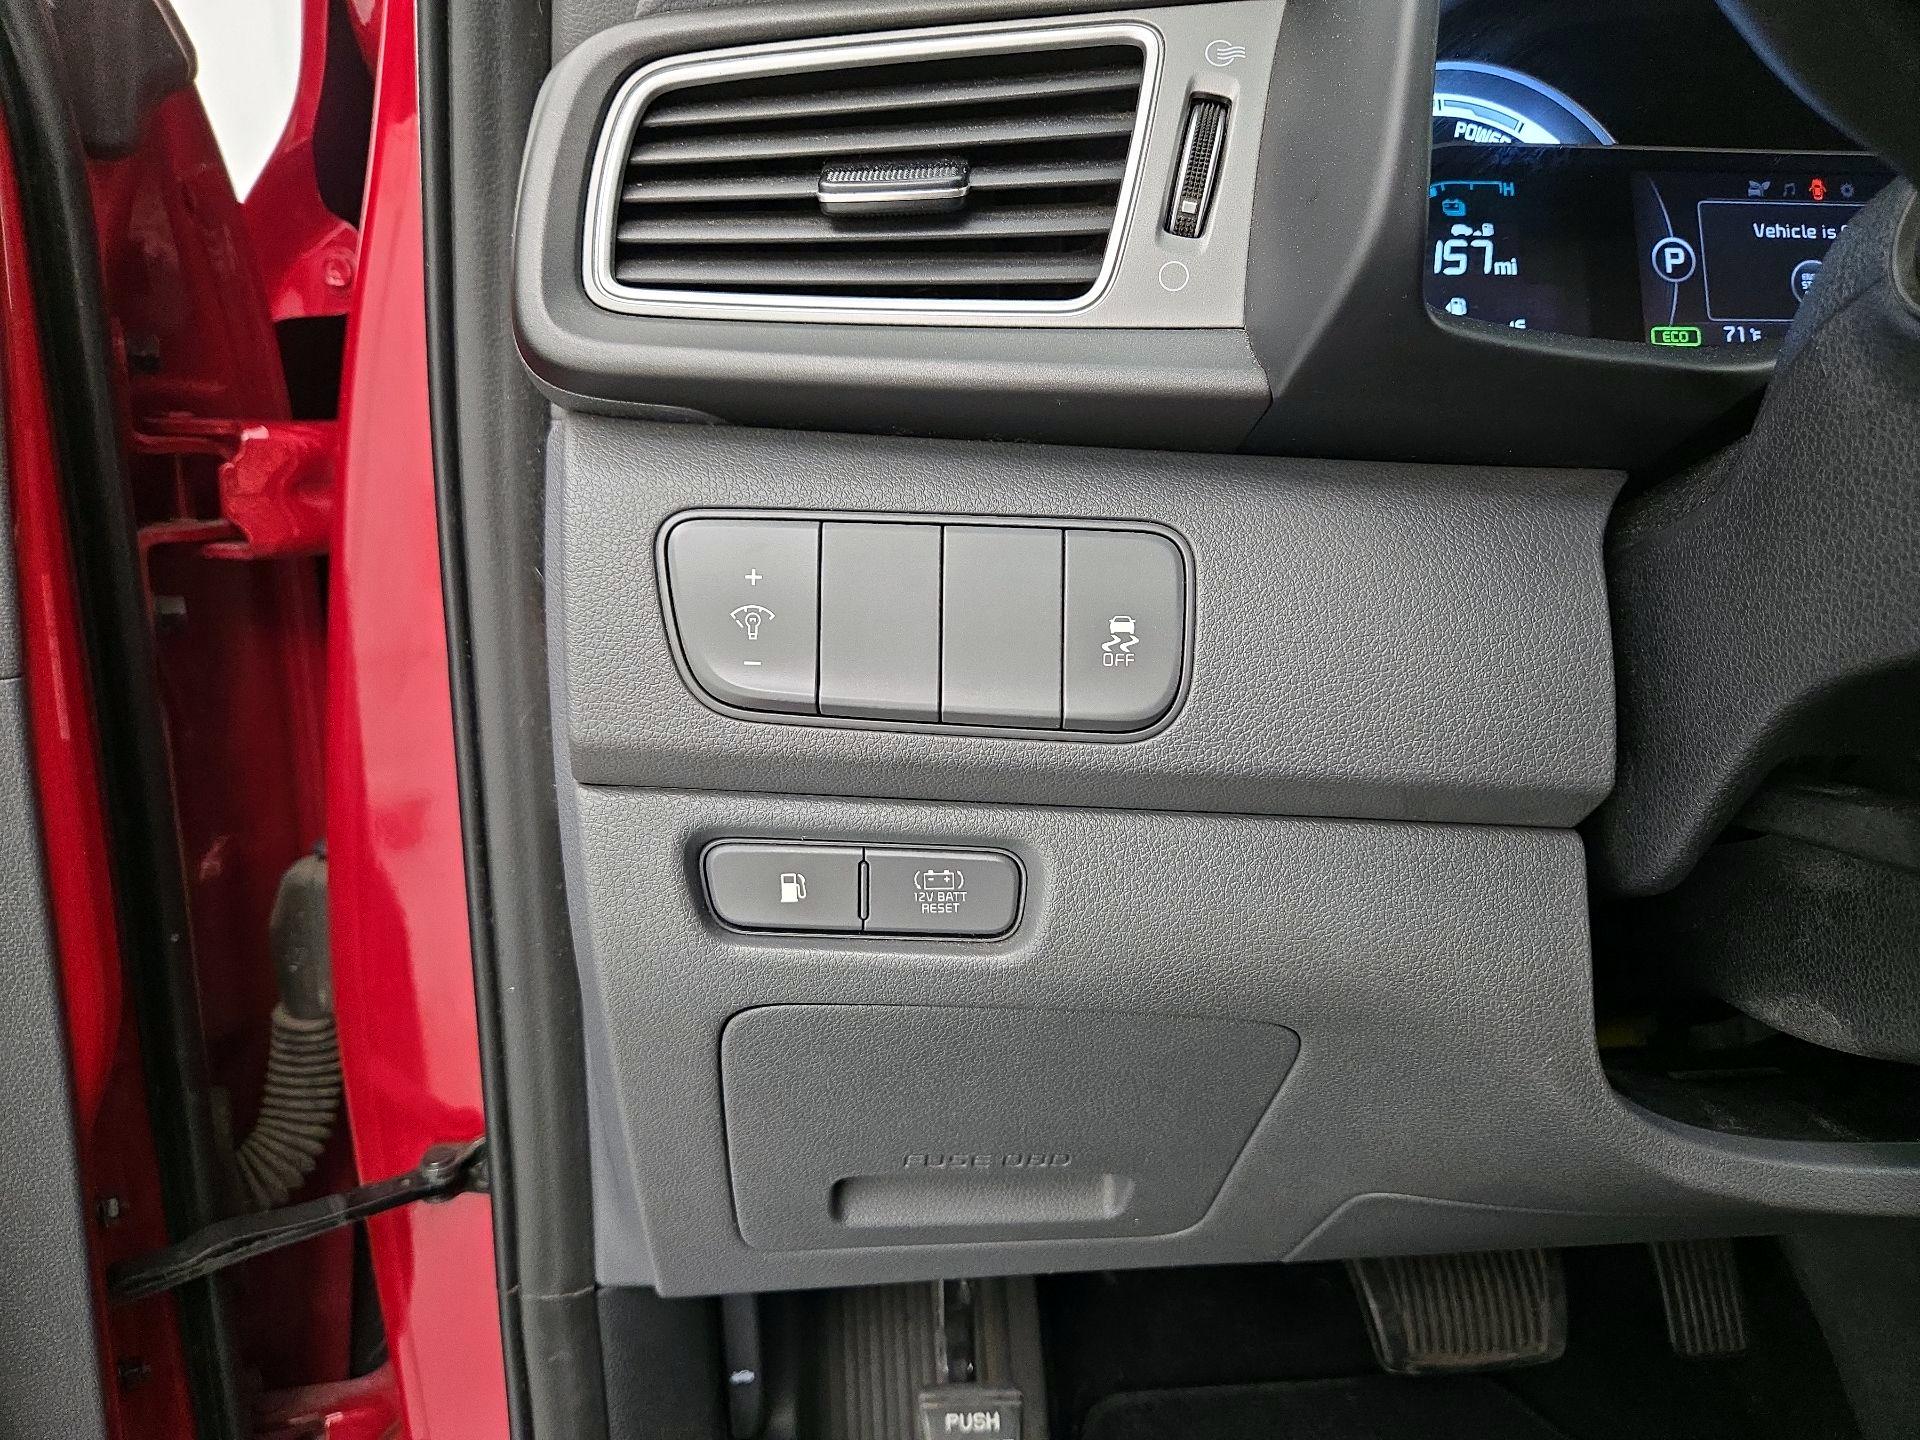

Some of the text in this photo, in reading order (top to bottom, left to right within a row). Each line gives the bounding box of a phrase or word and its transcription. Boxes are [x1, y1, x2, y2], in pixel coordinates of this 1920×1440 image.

[1503, 181, 1515, 197] H
[1752, 222, 1817, 239] Vehicle
[1821, 224, 1837, 239] is
[1664, 247, 1685, 273] P
[1662, 331, 1689, 343] ECO
[1102, 652, 1135, 667] OFF
[913, 891, 968, 902] 12V BATT
[921, 902, 960, 914] RESET
[903, 1152, 1072, 1169] FUSE OBD
[945, 1410, 1001, 1434] PUSH
